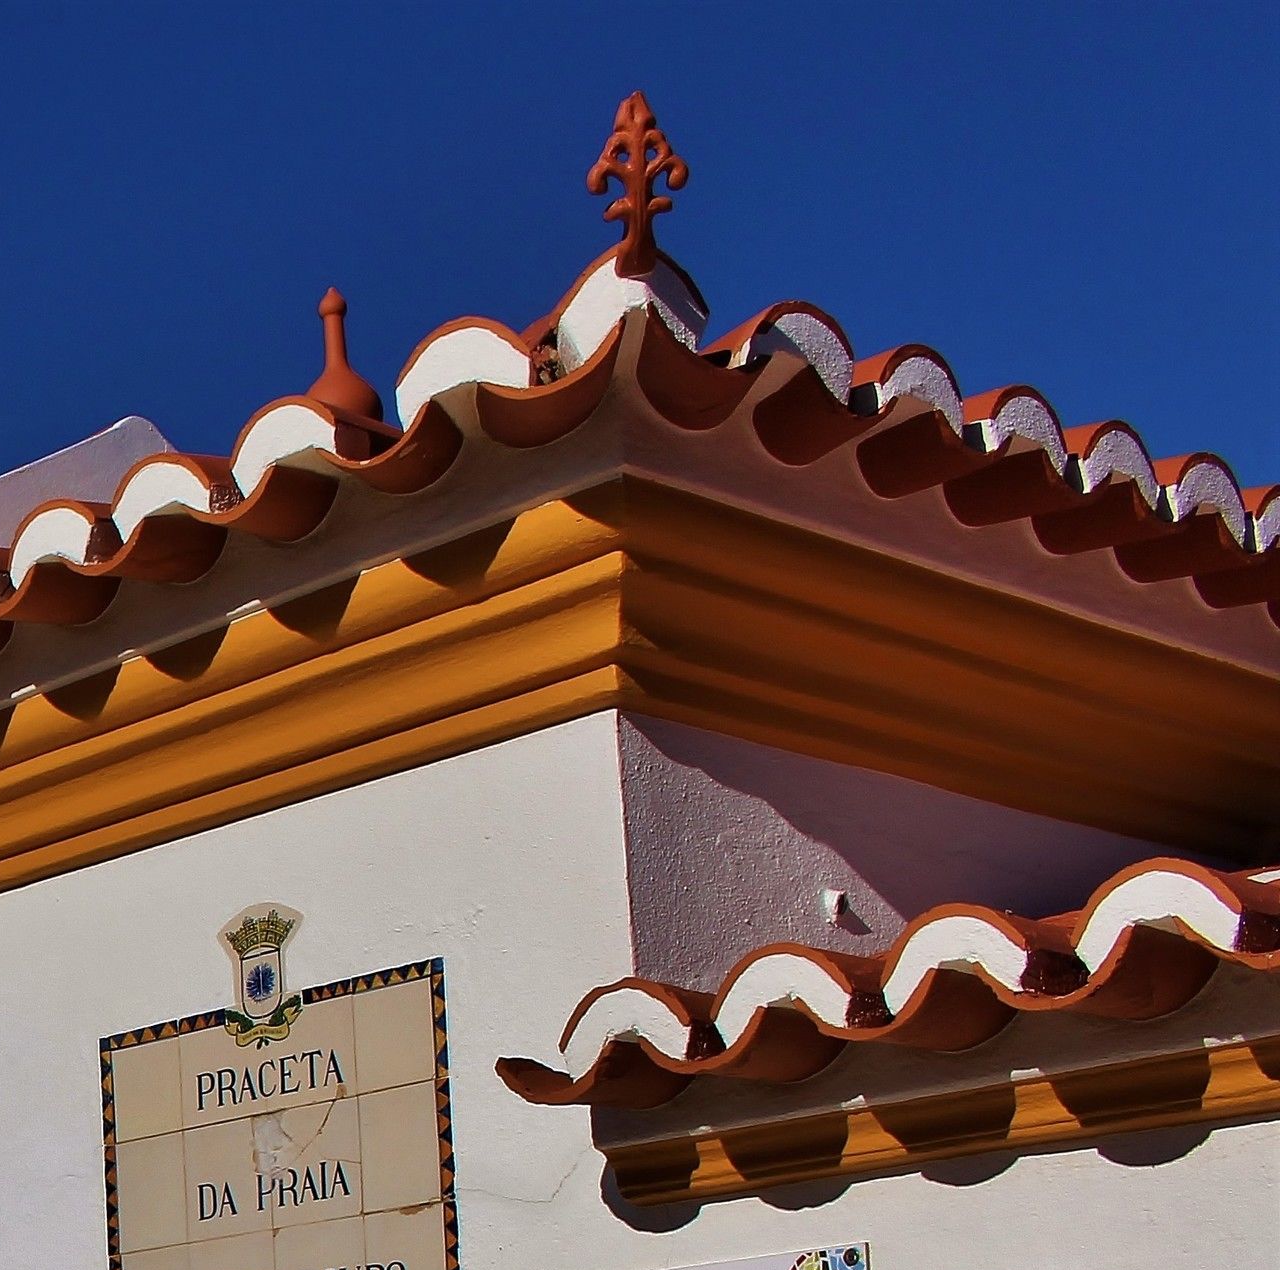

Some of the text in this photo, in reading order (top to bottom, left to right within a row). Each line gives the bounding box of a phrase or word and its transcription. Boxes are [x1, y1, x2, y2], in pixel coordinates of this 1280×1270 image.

[196, 1049, 344, 1111] PRACETA
[197, 1160, 351, 1222] DA PRAIA
